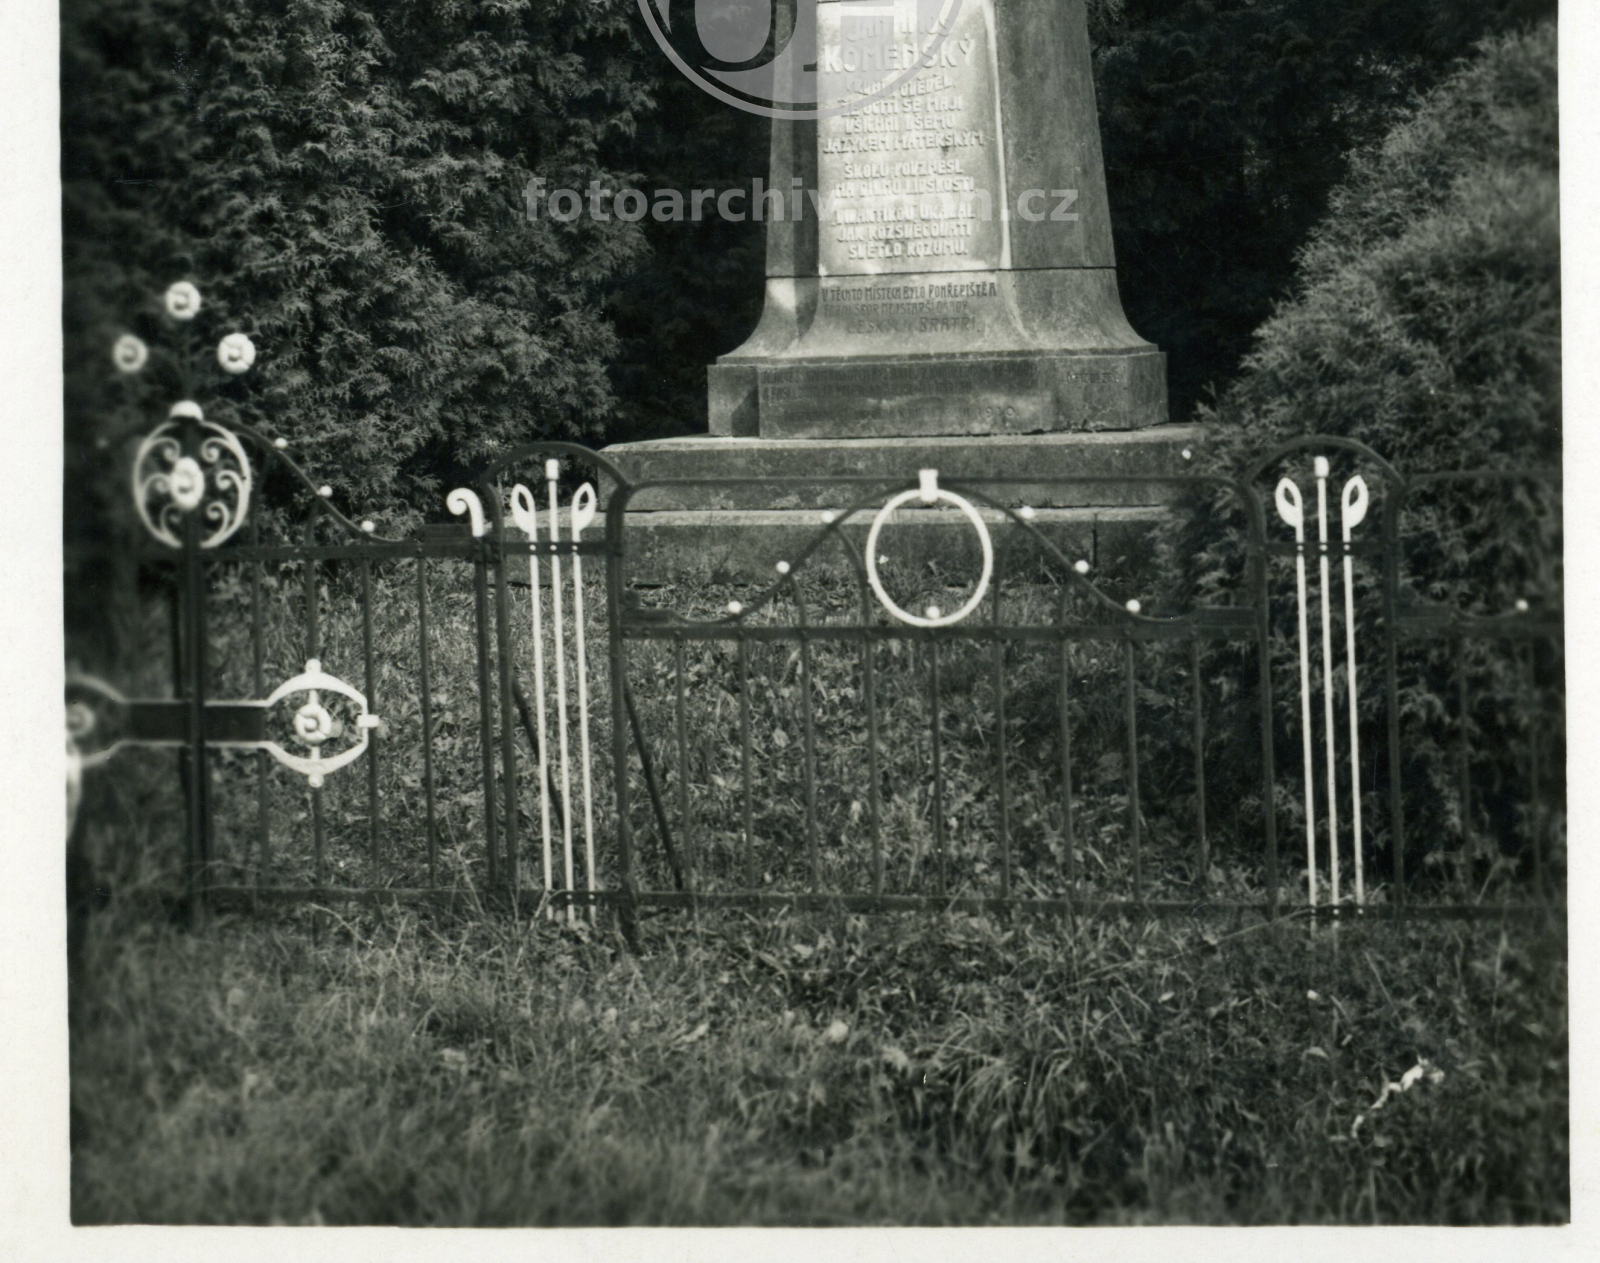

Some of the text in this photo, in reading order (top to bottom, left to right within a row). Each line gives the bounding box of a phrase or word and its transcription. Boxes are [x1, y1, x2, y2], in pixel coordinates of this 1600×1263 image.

[845, 16, 891, 42] JAN
[823, 33, 977, 73] KOMENSKÝ
[903, 97, 922, 114] SE
[823, 135, 891, 154] JAZYKEM
[845, 158, 965, 181] ŠKOLU POVZNESL
[835, 183, 855, 199] NA
[837, 224, 865, 243] JAK
[849, 241, 904, 261] SVĚTLO
[830, 286, 863, 302] TĚCHTO
[903, 285, 926, 301] BYLO
